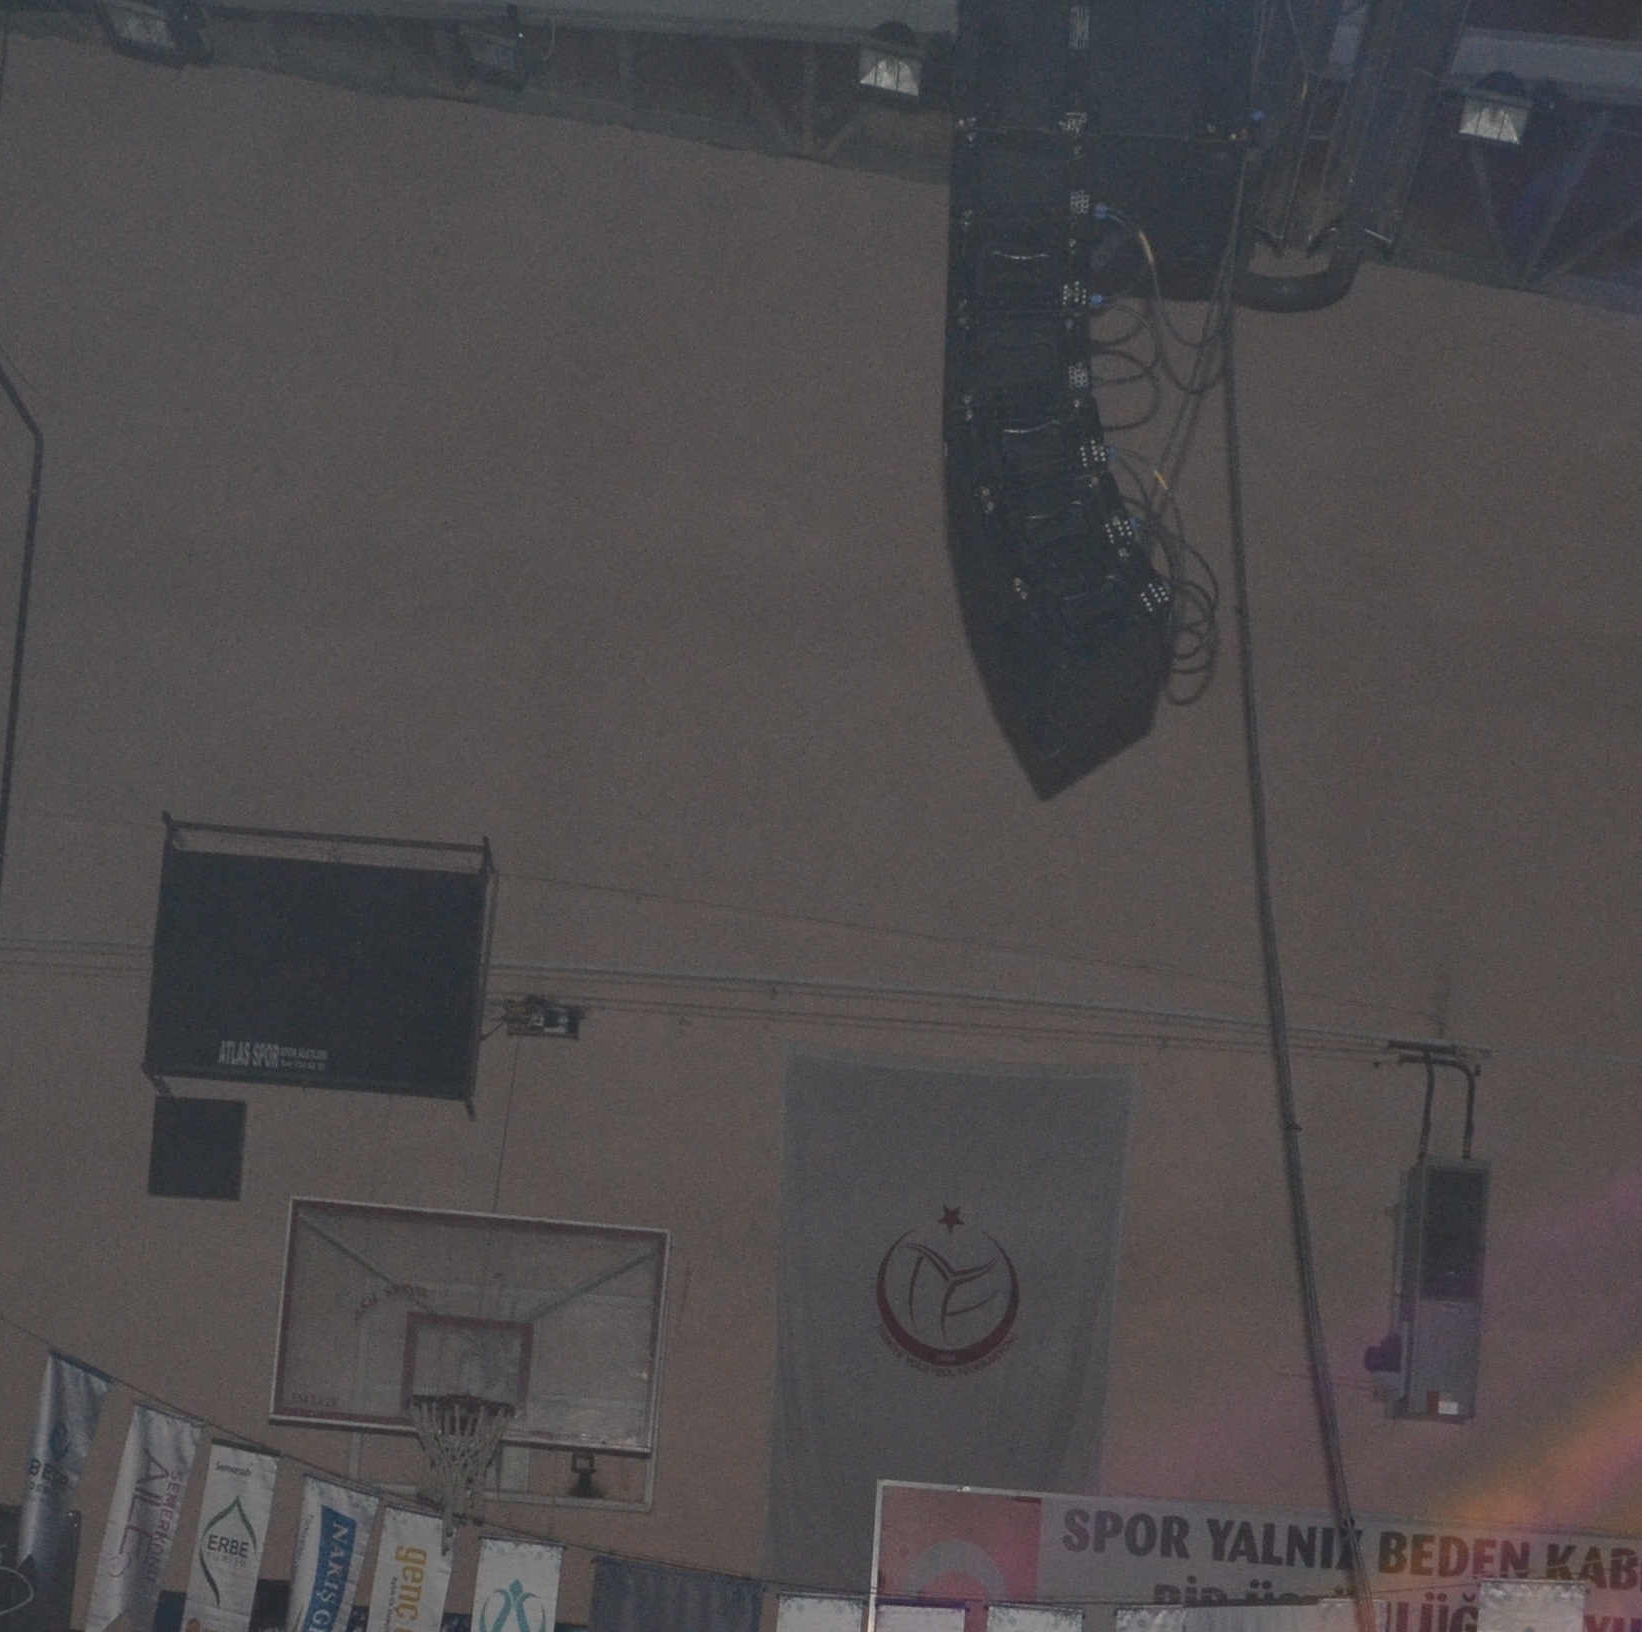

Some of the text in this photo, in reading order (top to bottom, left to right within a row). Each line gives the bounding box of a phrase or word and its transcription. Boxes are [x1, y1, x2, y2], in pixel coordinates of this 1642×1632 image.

[218, 1039, 251, 1067] ATLAS
[252, 1042, 280, 1068] SPOR
[207, 1534, 250, 1559] ERBE
[316, 1522, 349, 1605] NAKIŞ
[1062, 1508, 1190, 1560] SPOR
[1378, 1531, 1530, 1580] BEDEN
[393, 1546, 428, 1622] genç
